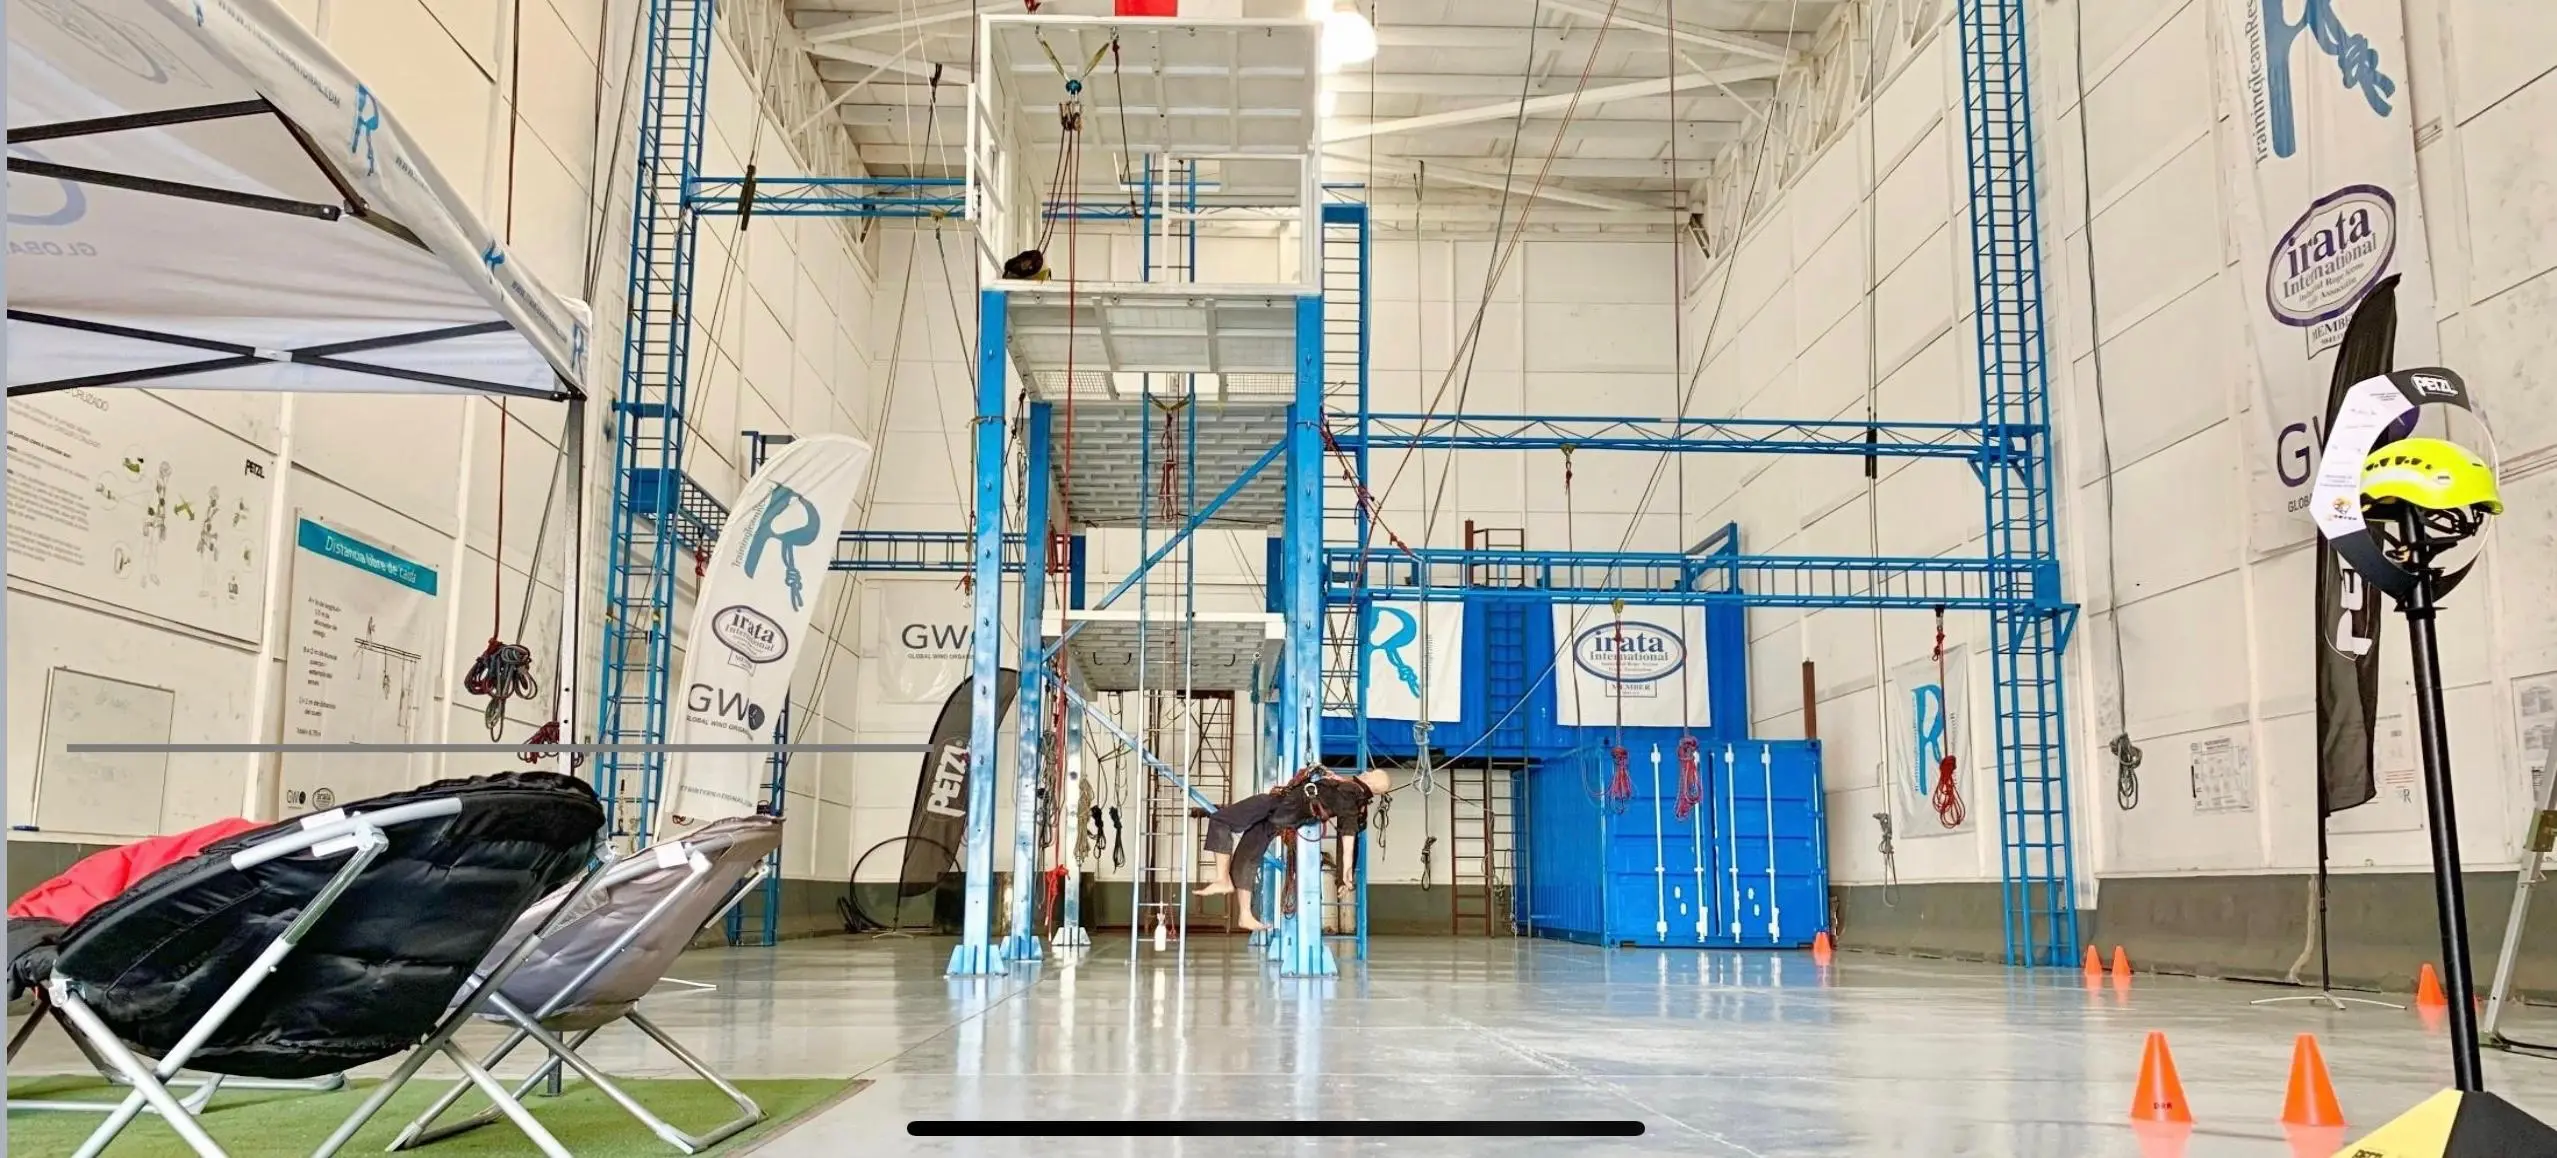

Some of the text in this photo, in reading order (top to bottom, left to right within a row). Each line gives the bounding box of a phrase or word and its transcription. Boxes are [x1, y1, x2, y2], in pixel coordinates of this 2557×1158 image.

[2287, 207, 2373, 279] irata
[2283, 232, 2378, 299] International
[2311, 314, 2352, 342] MEMBE
[2411, 375, 2459, 397] PETZL
[244, 458, 266, 480] PETZL
[731, 608, 775, 644] irata
[1594, 630, 1665, 653] irata
[1589, 651, 1669, 662] International
